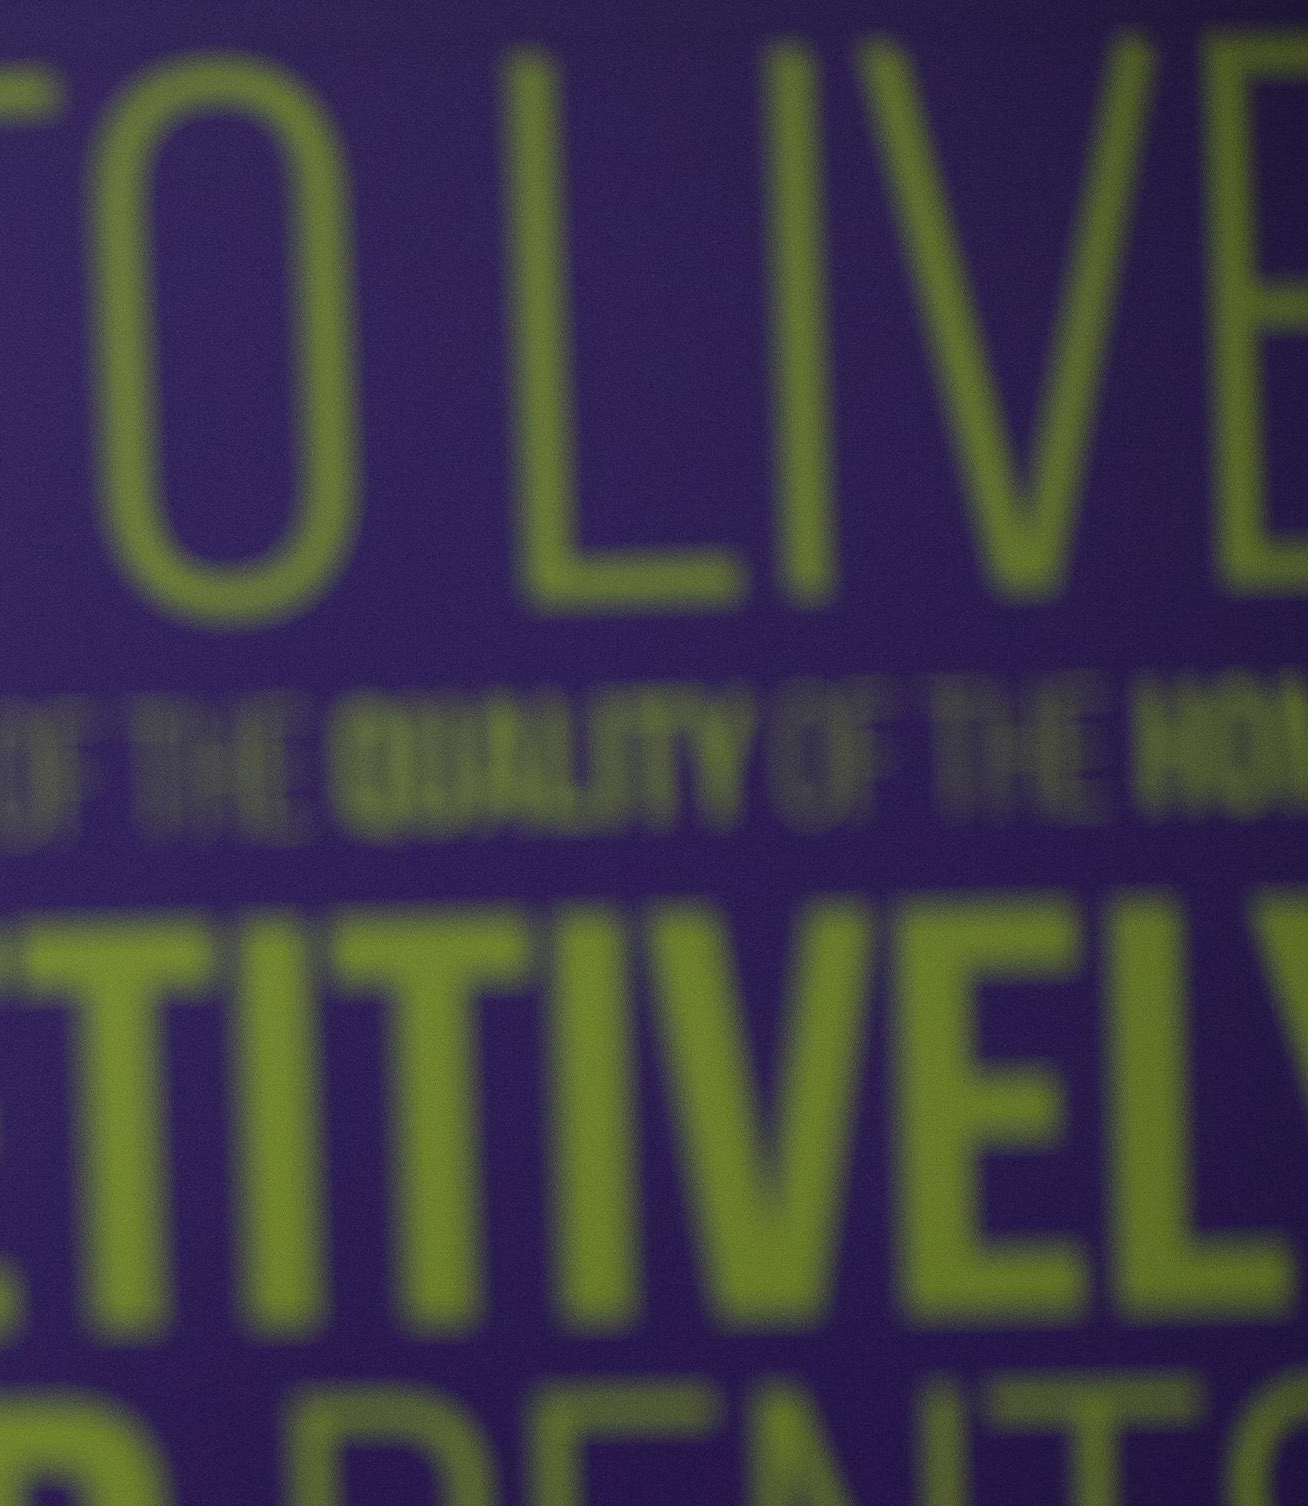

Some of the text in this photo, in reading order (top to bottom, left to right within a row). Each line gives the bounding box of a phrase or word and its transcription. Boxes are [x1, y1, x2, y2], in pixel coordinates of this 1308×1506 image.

[498, 25, 1308, 615] LIVE
[121, 690, 321, 850] THE
[326, 680, 761, 845] QUALITY
[771, 674, 893, 836] OF
[918, 668, 1121, 830] THE
